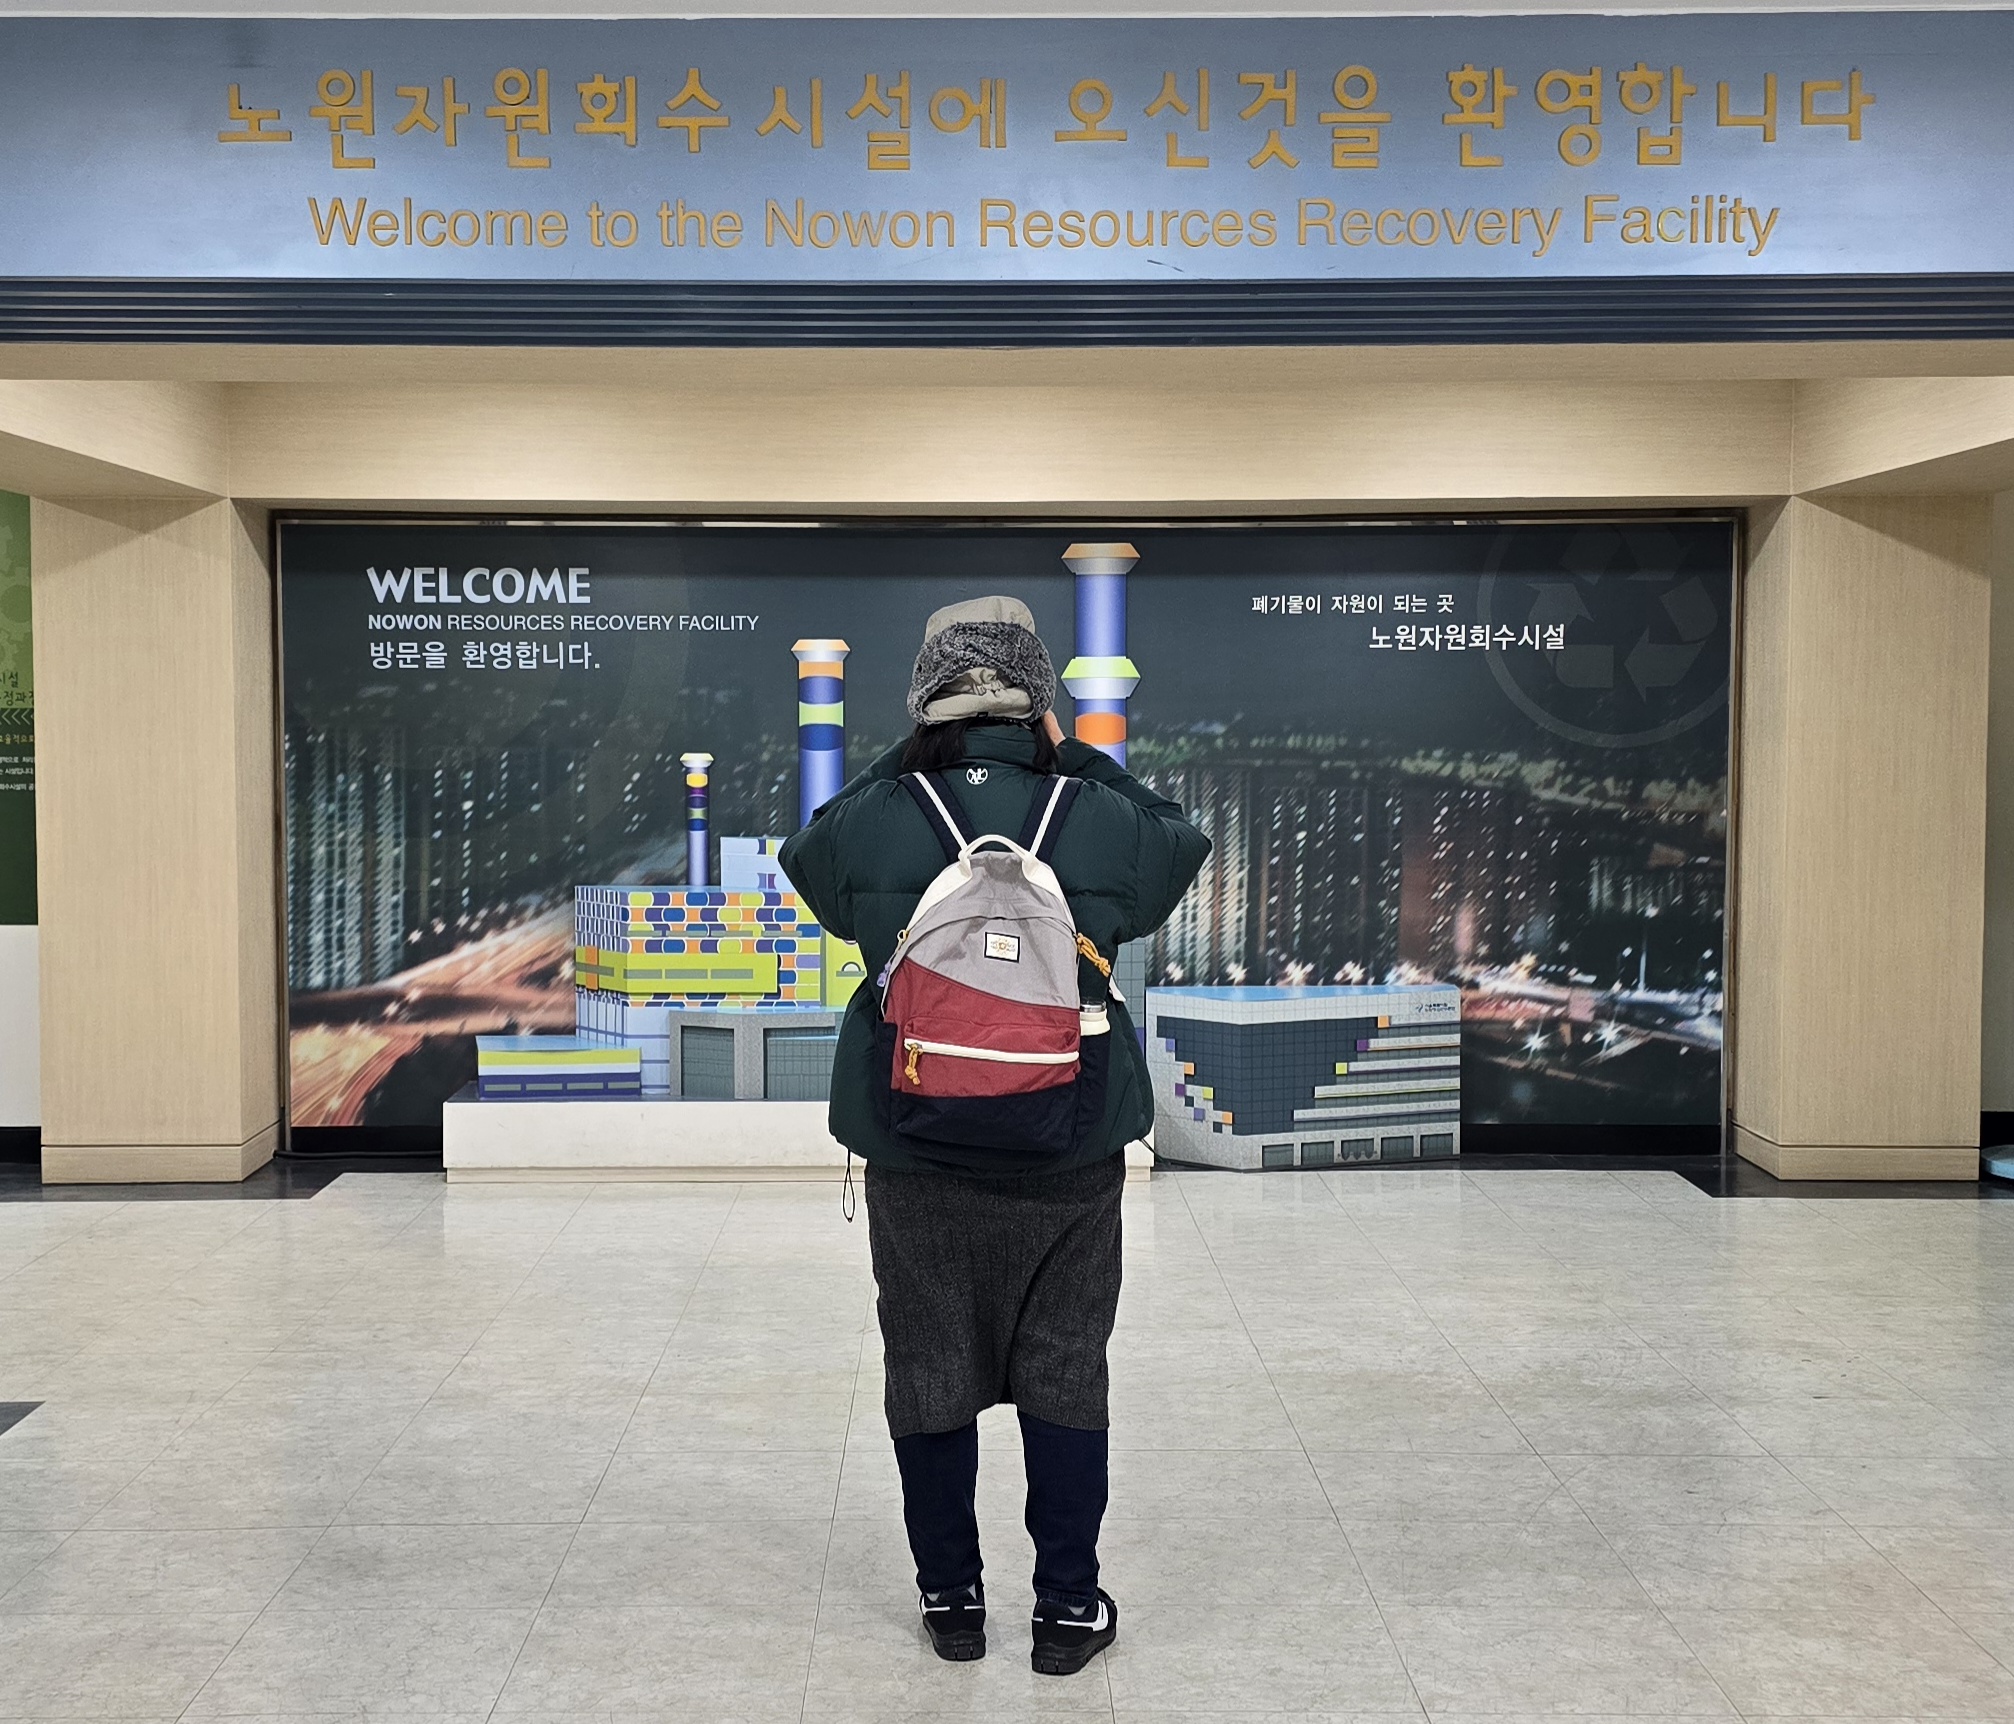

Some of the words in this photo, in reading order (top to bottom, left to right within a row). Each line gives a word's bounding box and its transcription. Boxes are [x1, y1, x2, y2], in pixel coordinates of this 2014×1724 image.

[217, 66, 1007, 171] 노원자원회수시설에
[1054, 64, 1392, 170] 오신것을
[1441, 62, 1877, 168] 환영합니다
[307, 197, 569, 247] Welcome
[588, 201, 638, 247] to
[657, 199, 743, 248] the
[764, 198, 955, 248] Nowon
[979, 198, 1278, 248] Resources
[1296, 197, 1562, 257] Recovery
[1583, 194, 1780, 256] Facility
[366, 566, 592, 604] WELCOME
[1251, 594, 1322, 615] 폐기물이
[1331, 594, 1384, 614] 자원이
[1392, 594, 1428, 614] 되는
[1436, 594, 1455, 614] 곳
[368, 614, 442, 631] NOWON
[447, 614, 565, 632] RESOURCES
[570, 614, 673, 632] RECOVERY
[679, 614, 760, 632] FACILITY
[1369, 623, 1566, 651] 노원자원회수시설
[369, 641, 448, 671] 방문을
[461, 641, 601, 671] 환영합니다.
